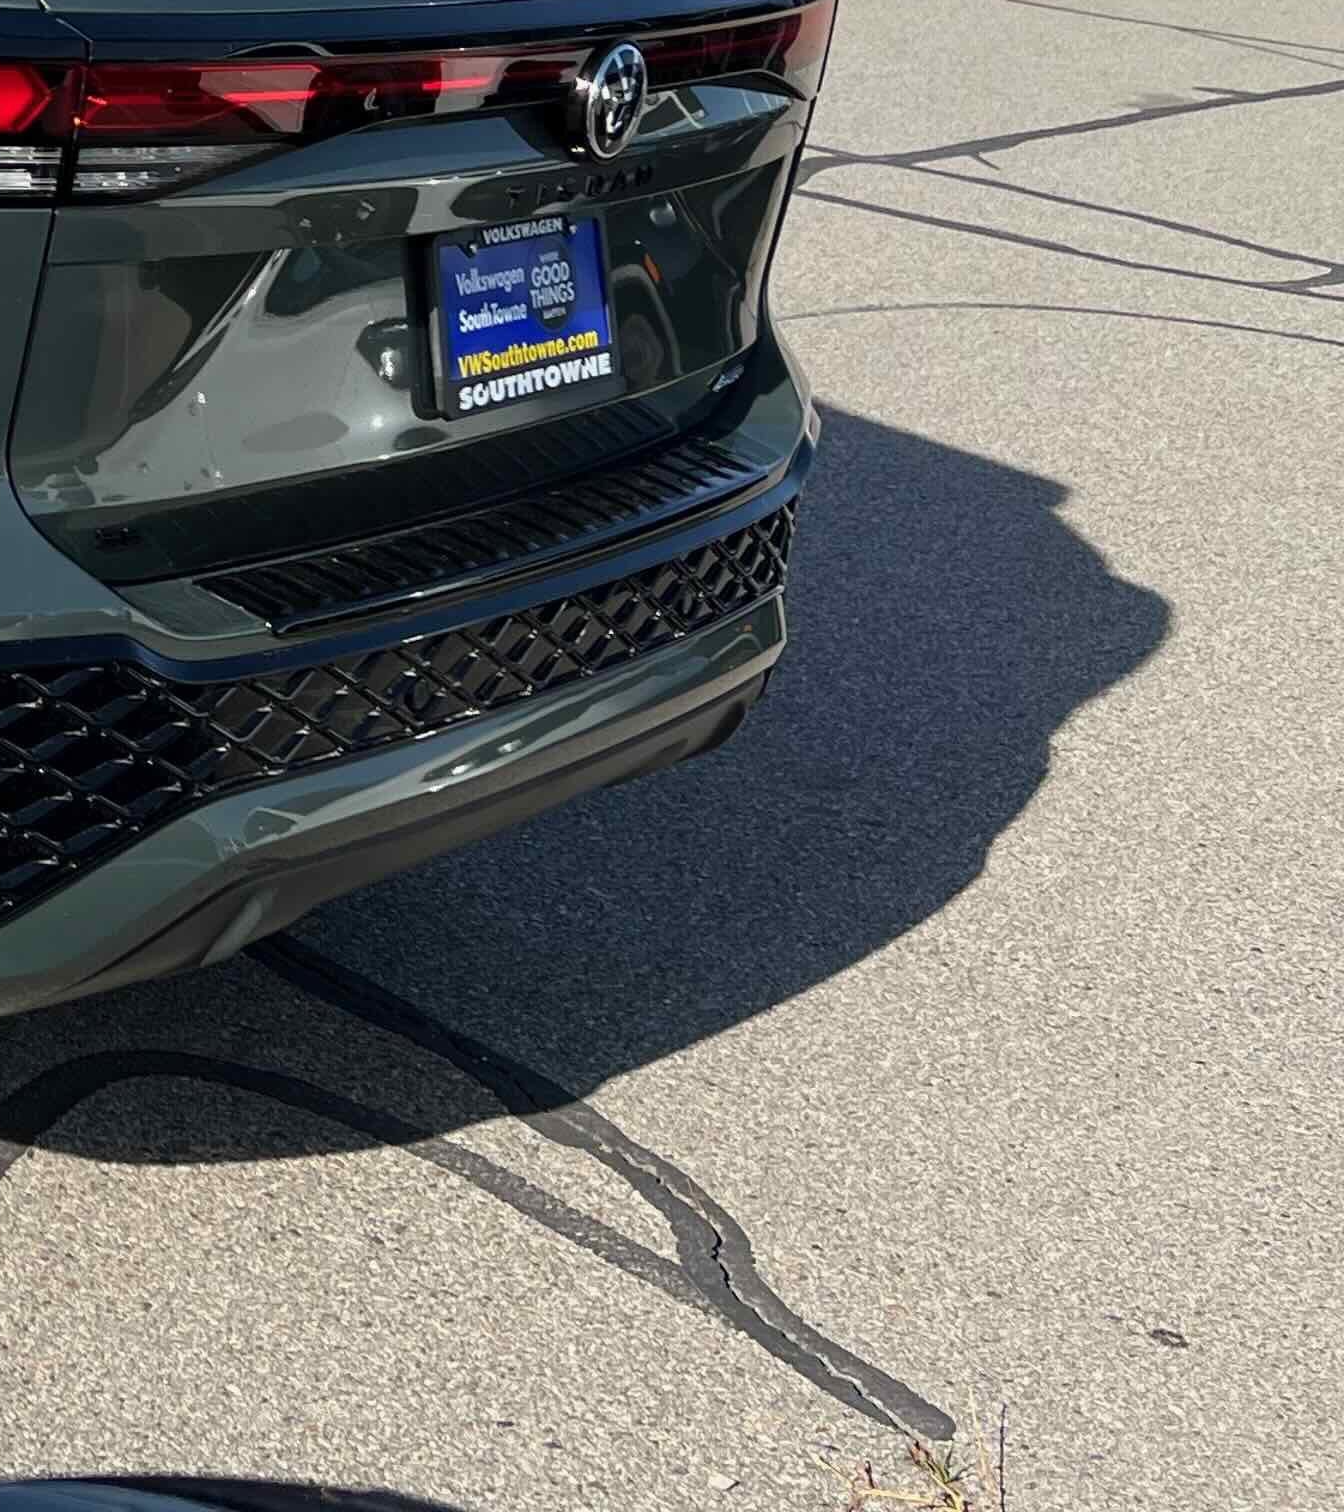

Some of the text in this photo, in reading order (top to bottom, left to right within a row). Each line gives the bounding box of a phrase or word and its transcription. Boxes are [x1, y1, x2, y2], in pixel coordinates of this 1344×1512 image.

[482, 217, 563, 245] VOLKSWAGEN
[455, 267, 525, 297] Volkswagen
[531, 261, 570, 287] GOOD
[529, 281, 575, 309] THINGS
[457, 330, 599, 378] VWSouthtowne.com
[458, 352, 612, 411] SOUTHTOWNE
